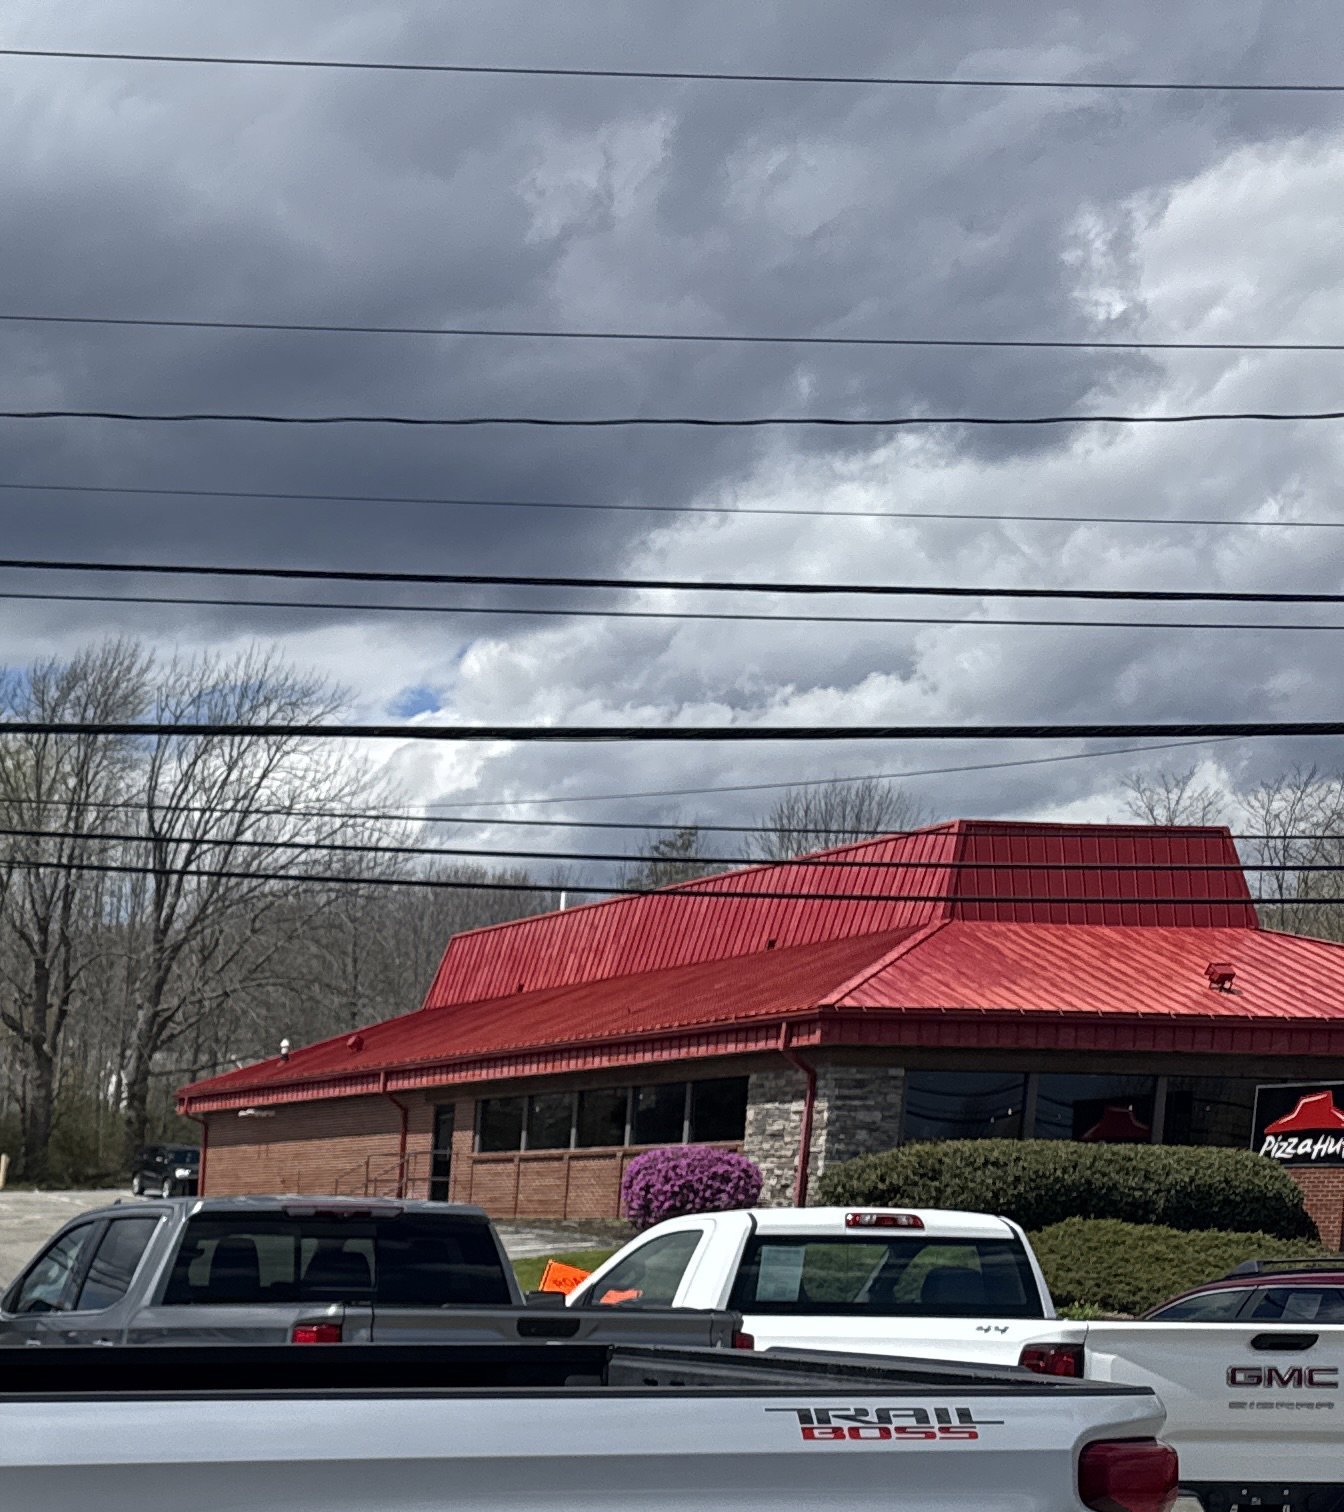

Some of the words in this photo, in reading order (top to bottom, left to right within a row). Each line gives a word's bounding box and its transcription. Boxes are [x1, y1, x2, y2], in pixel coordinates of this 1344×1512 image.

[1226, 1365, 1339, 1389] GMC
[765, 1407, 1005, 1425] TRAIL
[800, 1426, 979, 1441] BOSS
